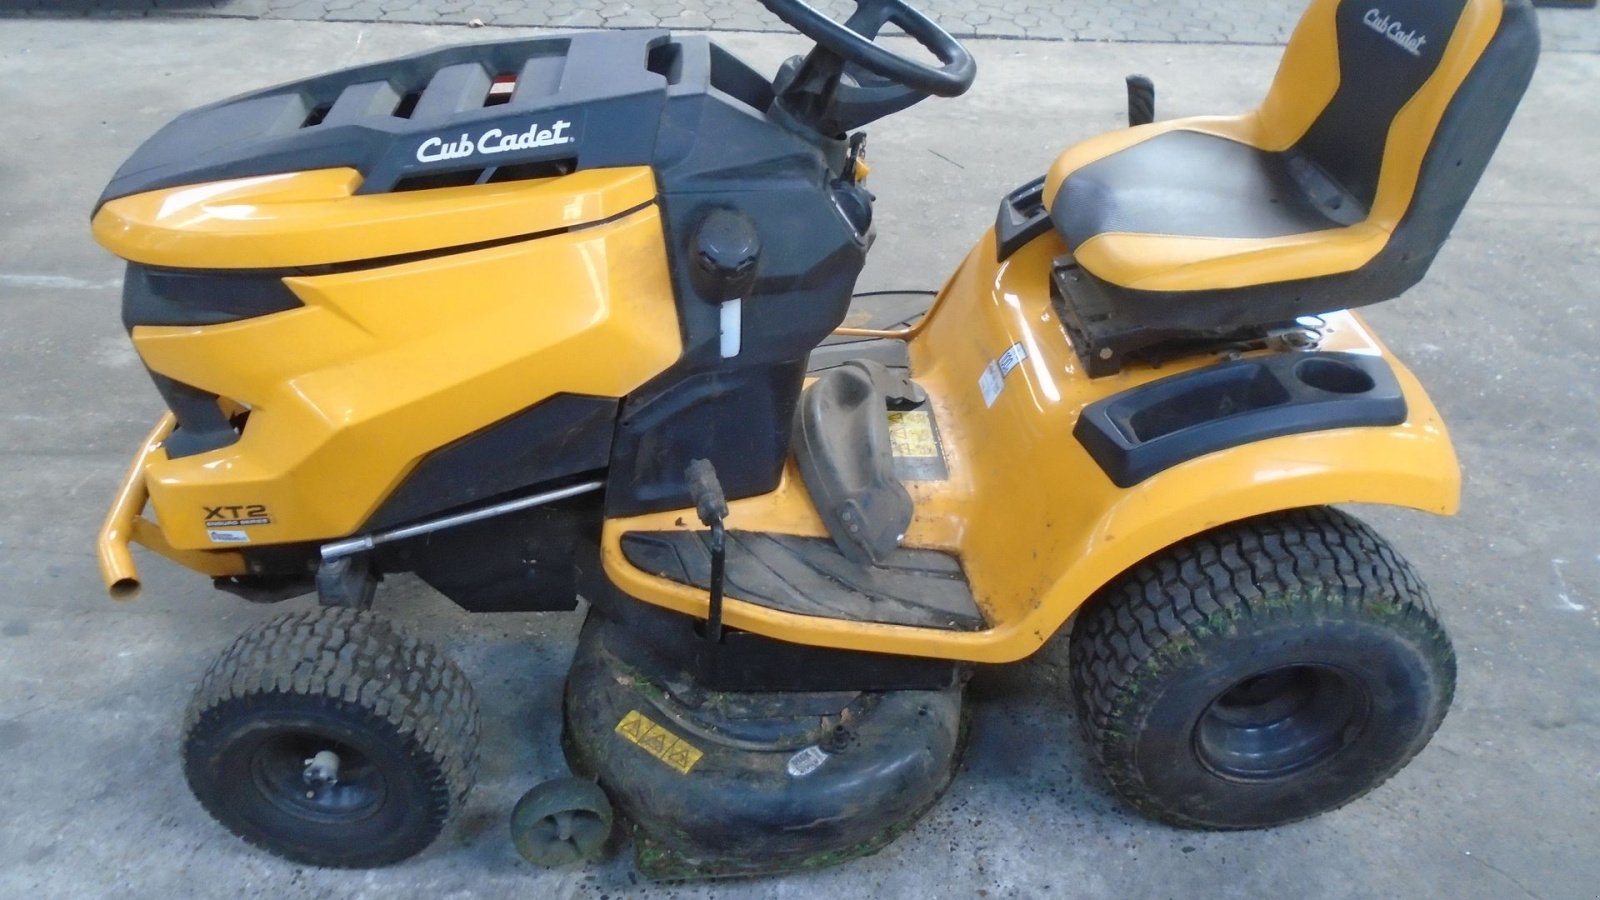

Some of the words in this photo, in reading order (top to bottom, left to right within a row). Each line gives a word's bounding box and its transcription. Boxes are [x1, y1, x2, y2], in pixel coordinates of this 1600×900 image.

[1363, 8, 1391, 34] Cub
[1386, 22, 1426, 57] Cadet
[416, 133, 474, 163] Cub
[477, 120, 571, 154] Cadet
[203, 505, 268, 520] XT2
